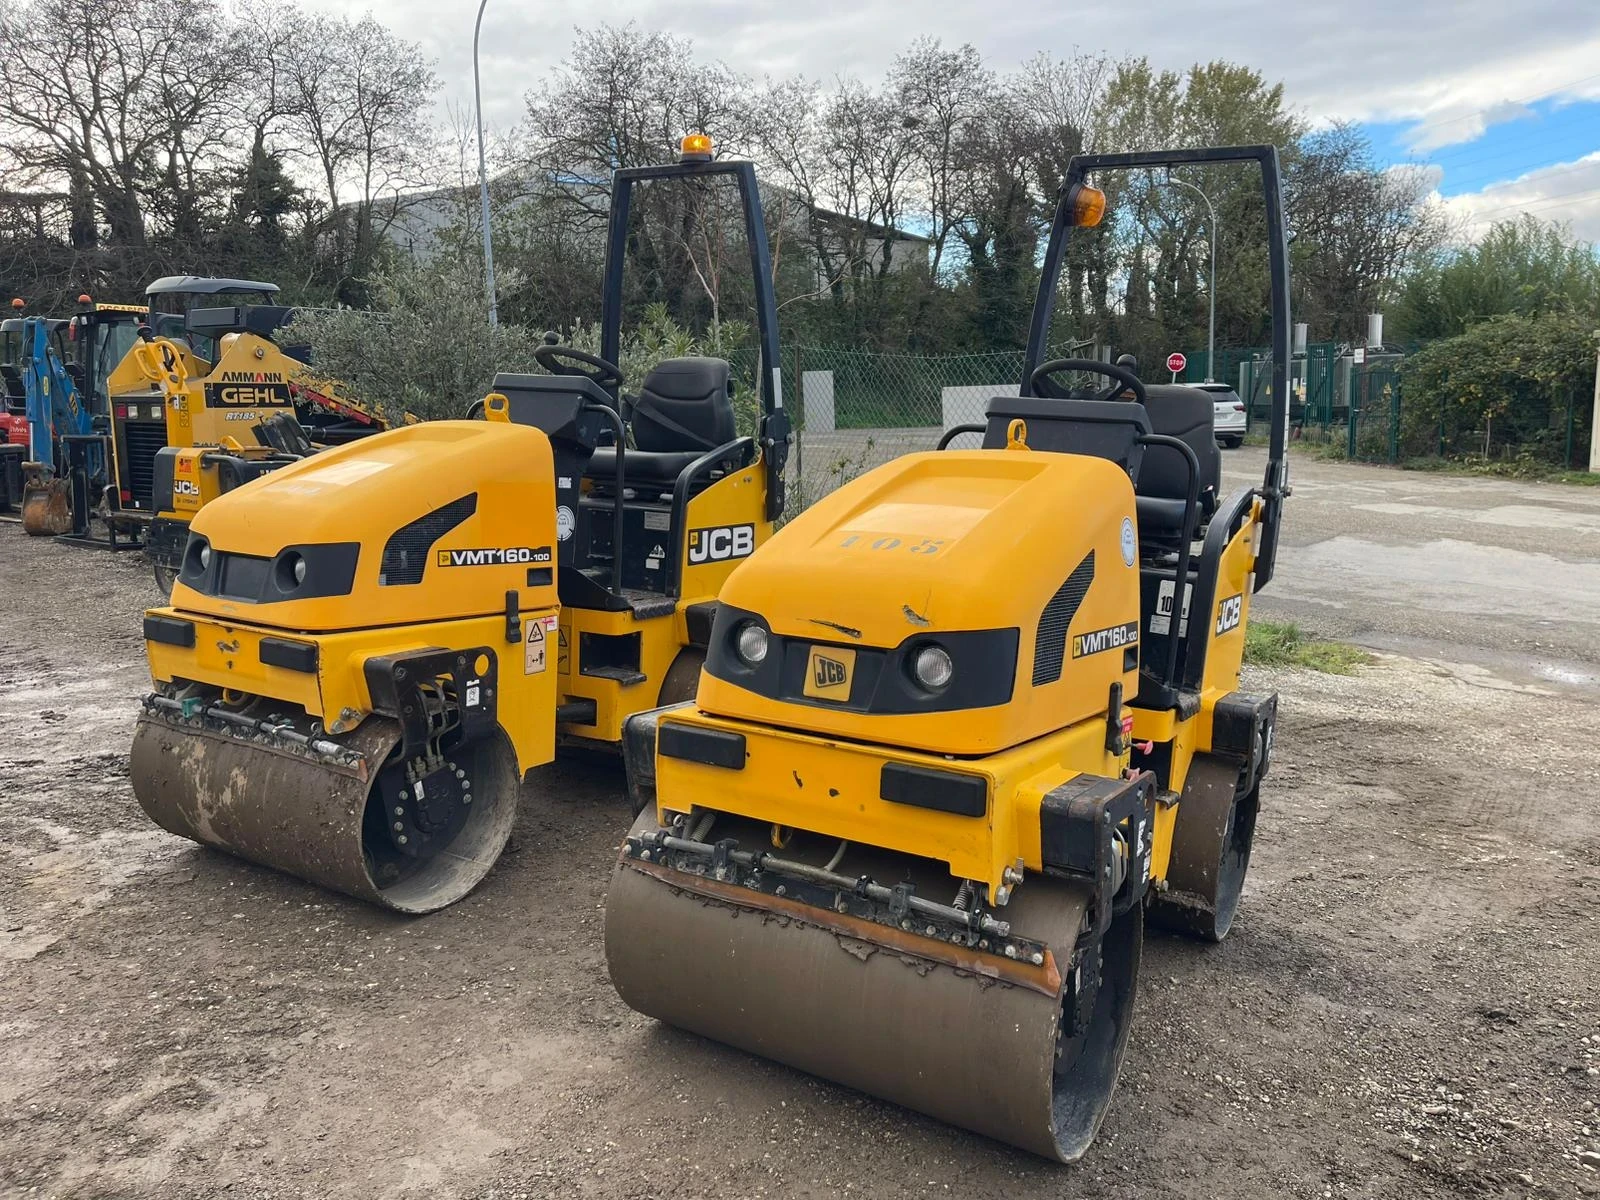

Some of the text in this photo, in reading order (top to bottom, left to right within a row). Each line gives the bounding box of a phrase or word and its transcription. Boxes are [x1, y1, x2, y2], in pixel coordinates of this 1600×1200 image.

[222, 371, 282, 382] AMMANN
[221, 387, 285, 404] GEHL
[225, 411, 256, 421] RT185
[174, 480, 199, 495] JCB
[690, 525, 754, 562] JCB
[840, 535, 944, 554] 105
[1216, 595, 1242, 634] JCB
[816, 657, 846, 686] JCB
